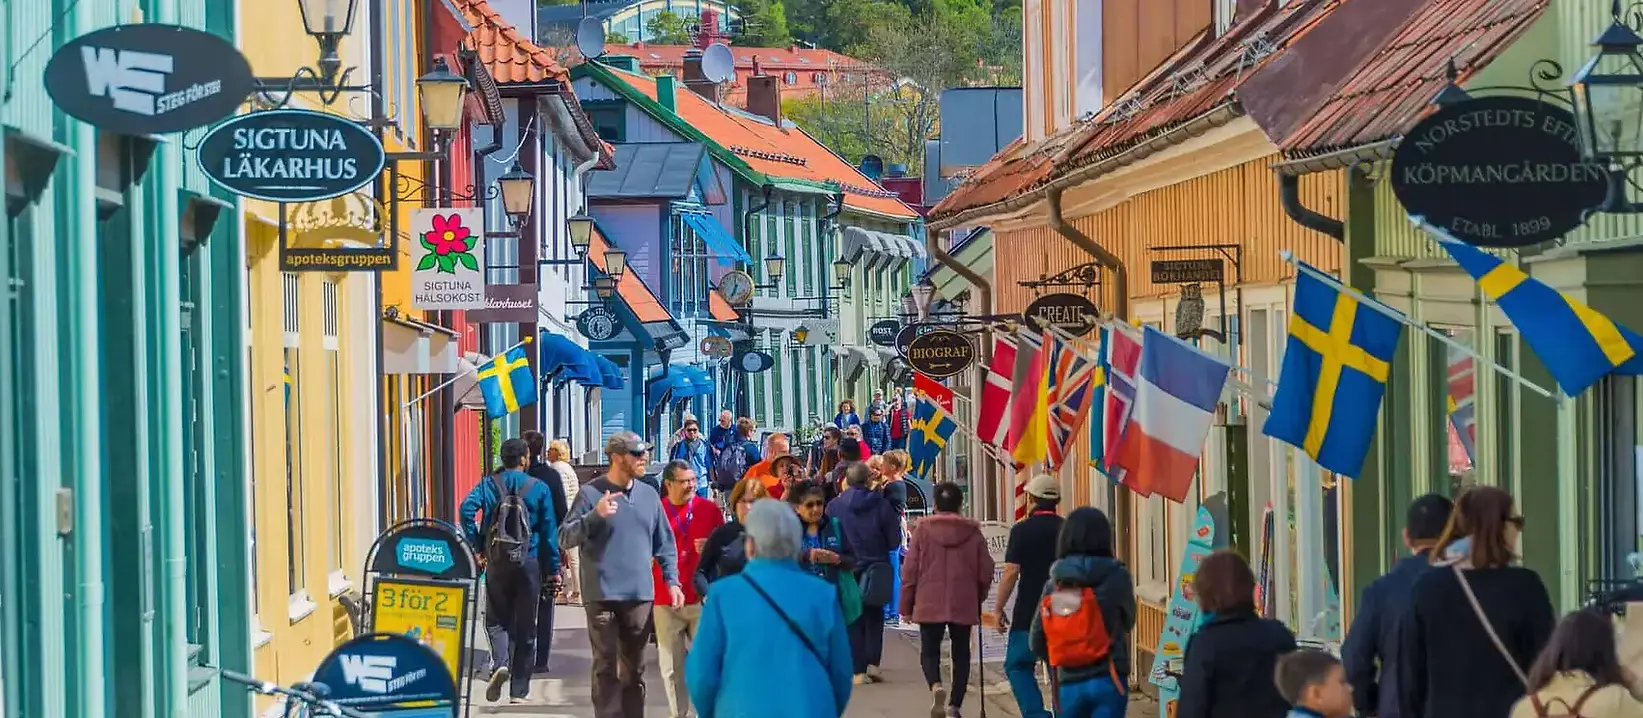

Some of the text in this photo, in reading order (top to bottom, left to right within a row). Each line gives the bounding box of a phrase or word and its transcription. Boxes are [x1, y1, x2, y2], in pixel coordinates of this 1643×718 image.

[81, 45, 173, 116] WE
[156, 90, 186, 114] STEG
[186, 83, 205, 105] FÖR
[234, 128, 347, 150] SIGTUNA
[1415, 109, 1535, 153] NORSTEDTS
[224, 153, 357, 179] LÄKARHUS
[1405, 160, 1602, 185] KÖPMANGÅRDEN
[1512, 215, 1551, 236] 1899
[286, 253, 391, 267] apoteksgruppen
[424, 281, 472, 291] SIGTUNA
[1039, 305, 1085, 322] CREATE
[912, 346, 968, 359] BIOGRAF
[403, 543, 443, 554] apoteks
[987, 535, 1008, 551] ATE
[402, 552, 445, 563] gruppen
[382, 588, 448, 612] 3 för 2
[338, 654, 397, 693] WE
